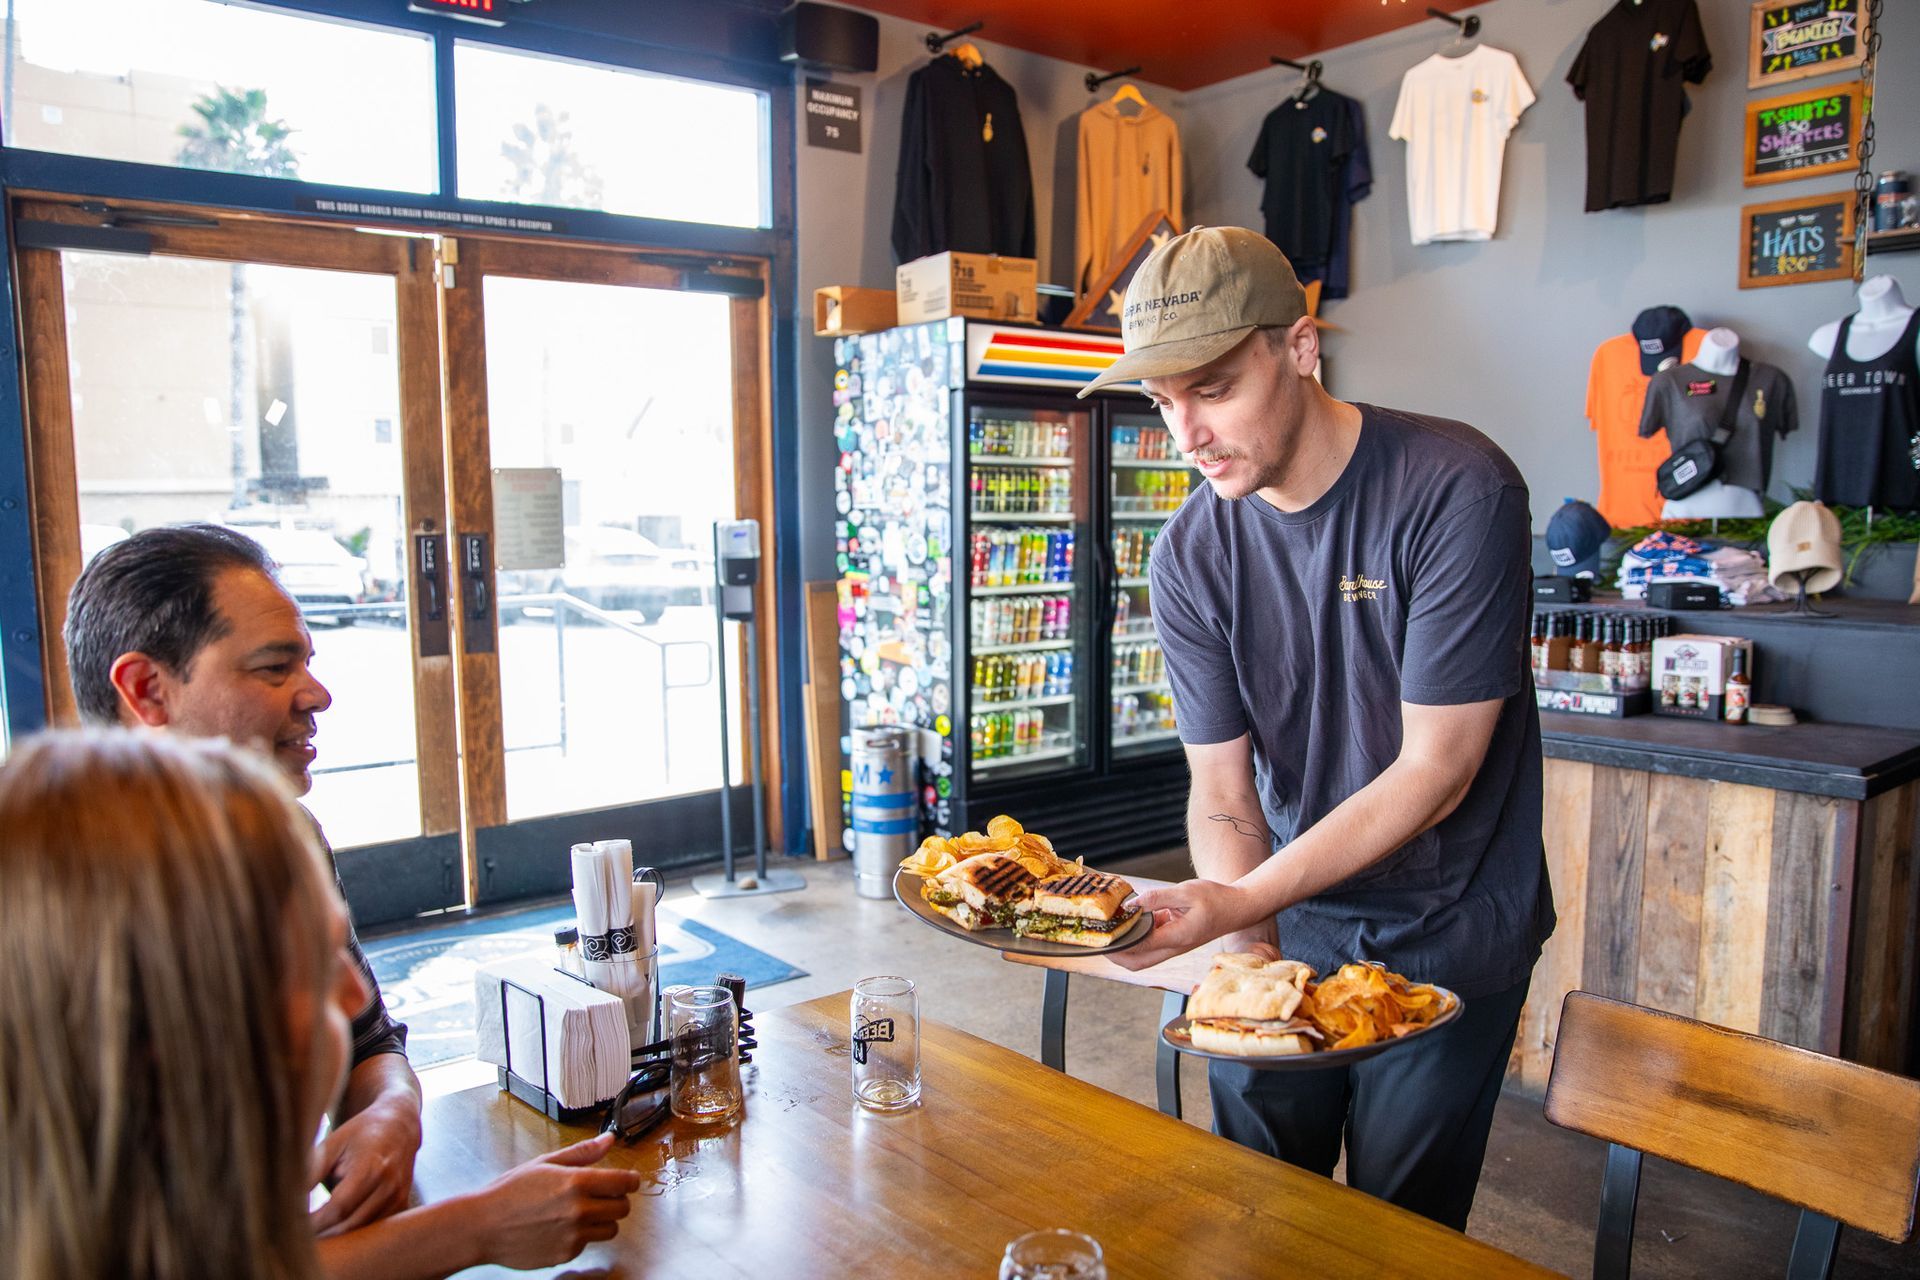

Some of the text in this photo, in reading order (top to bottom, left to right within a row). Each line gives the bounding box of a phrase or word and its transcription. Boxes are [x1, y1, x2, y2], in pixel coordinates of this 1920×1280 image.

[806, 101, 859, 121] OCCUPANCY
[811, 89, 854, 107] MAXIMUM
[1759, 121, 1845, 153] SWEATERS
[1762, 225, 1825, 257] HATS
